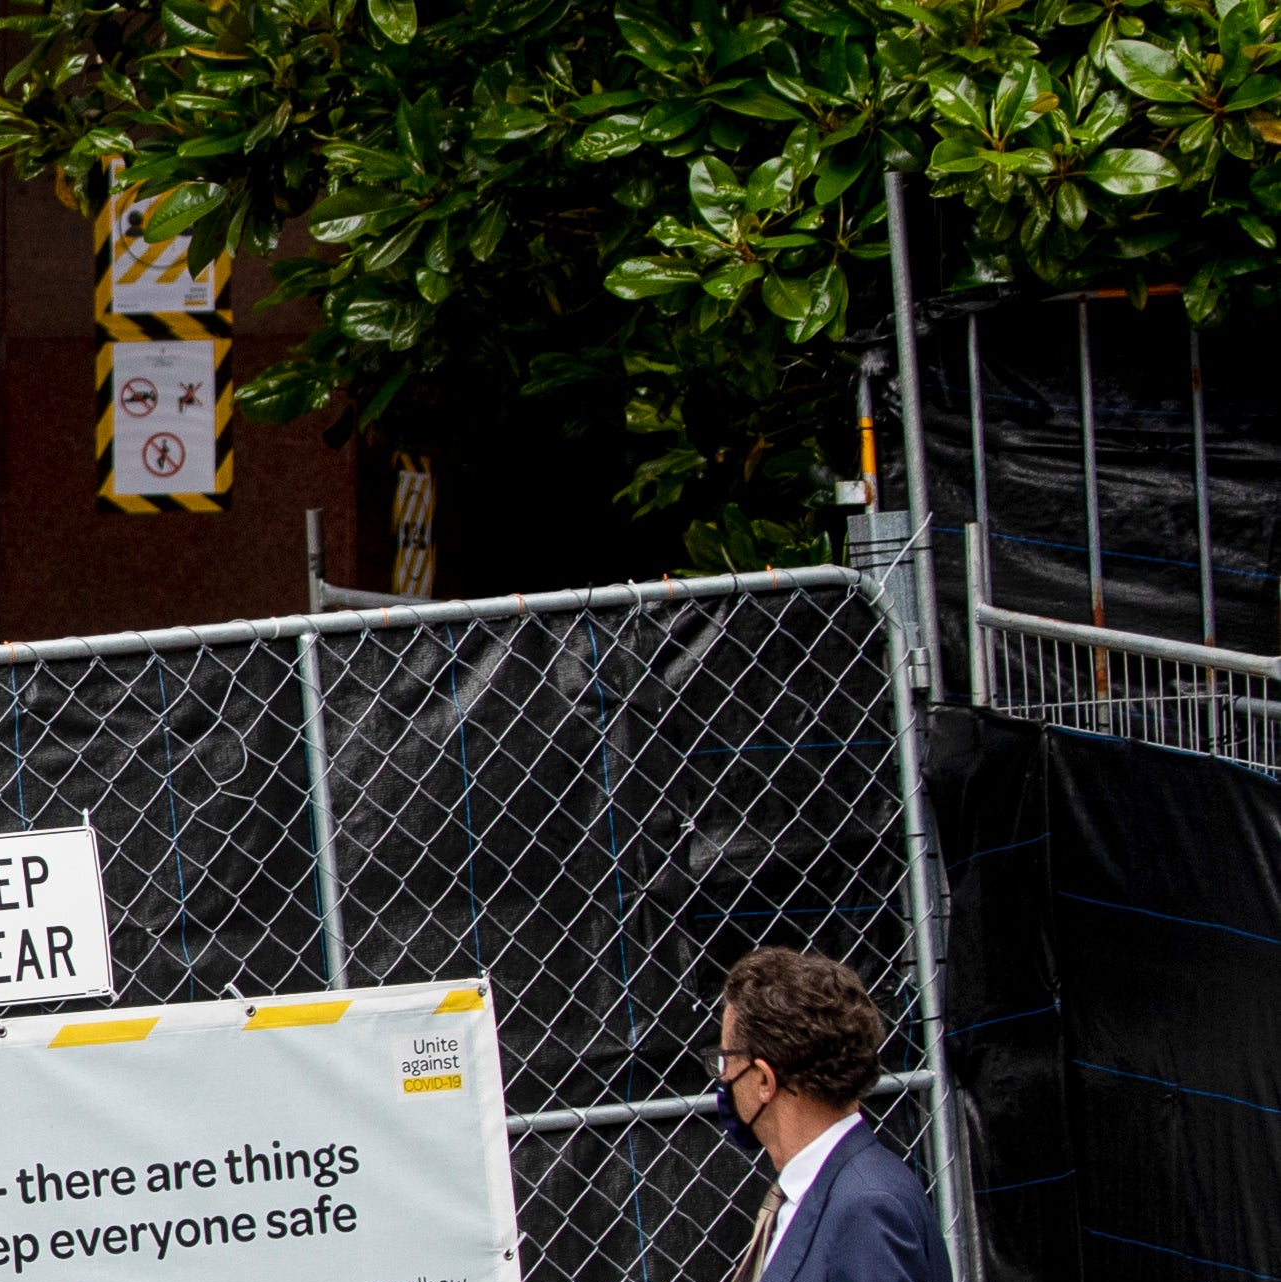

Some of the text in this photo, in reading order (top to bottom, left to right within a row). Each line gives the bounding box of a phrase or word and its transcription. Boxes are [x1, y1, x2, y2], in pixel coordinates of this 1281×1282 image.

[414, 1037, 458, 1054] Unite
[402, 1055, 460, 1076] against
[404, 1075, 461, 1092] COVID-19
[16, 1163, 135, 1204] there
[147, 1159, 216, 1192] are
[224, 1141, 359, 1187] things
[50, 1214, 256, 1260] everyone
[267, 1194, 356, 1239] safe
